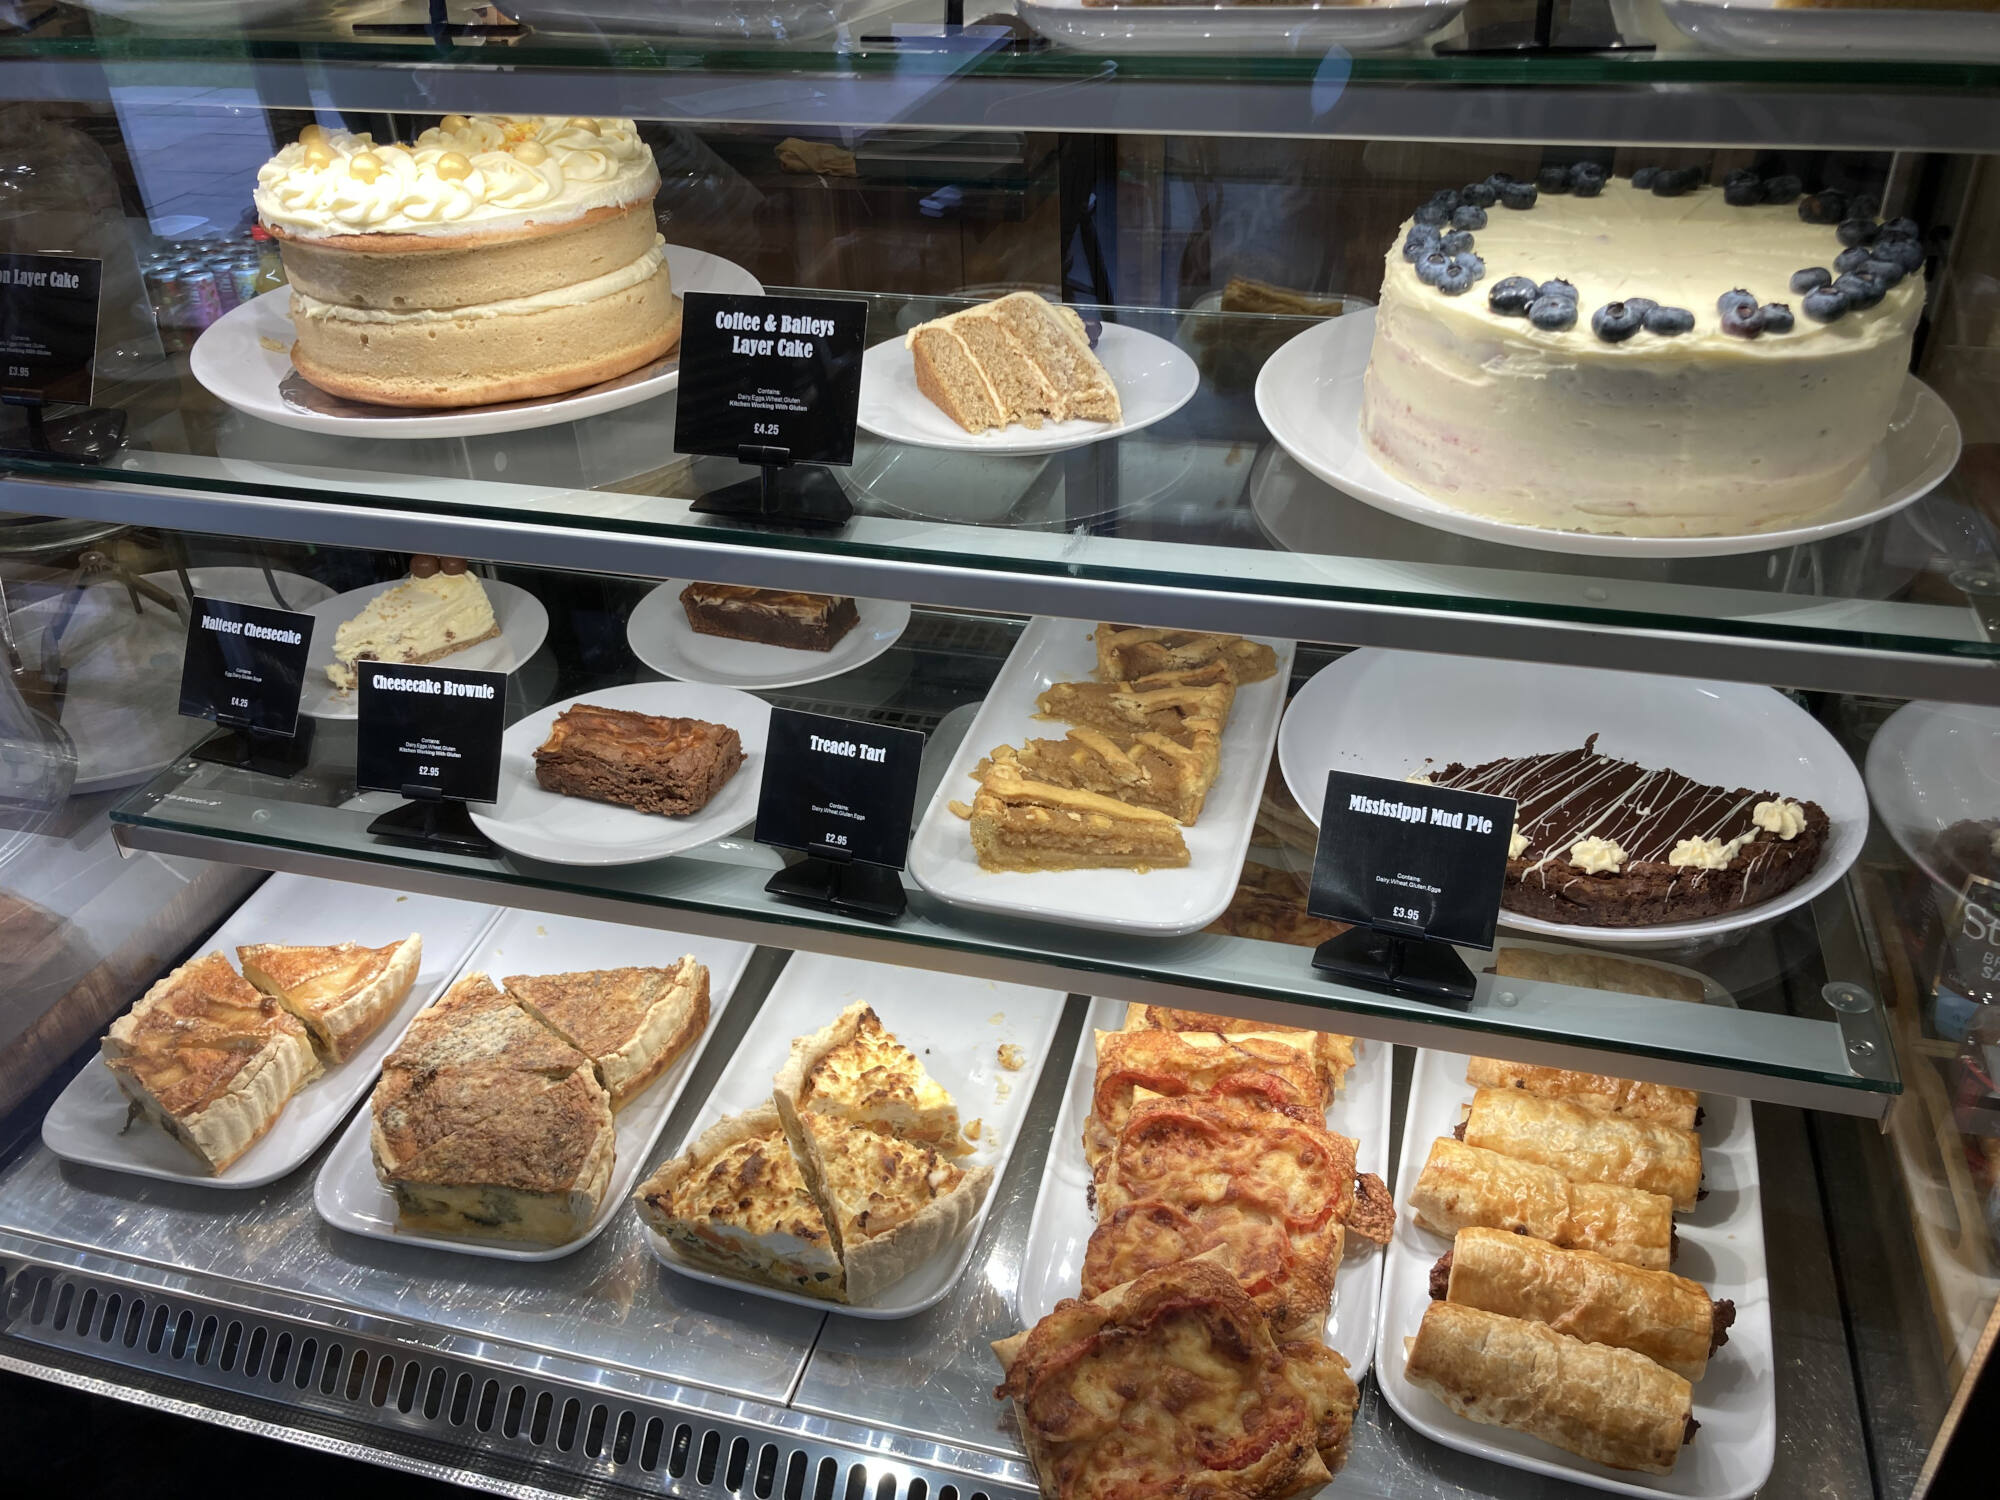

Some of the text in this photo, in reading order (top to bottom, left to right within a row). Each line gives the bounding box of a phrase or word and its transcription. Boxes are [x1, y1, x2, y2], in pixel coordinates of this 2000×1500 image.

[13, 268, 47, 287] Layer
[50, 271, 80, 289] Cake
[715, 311, 835, 338] Coffee & Baileys
[732, 336, 814, 358] Layer Cake
[8, 366, 30, 377] £3.95
[728, 400, 751, 408] Kitchen
[751, 402, 775, 410] Working
[788, 404, 808, 412] Gluten
[753, 422, 780, 435] £4.25
[201, 614, 302, 645] Malteser Cheesecake
[372, 674, 495, 700] Cheesecake Brownie
[231, 696, 248, 708] £4.25
[809, 734, 887, 763] Treacle Tart
[418, 765, 440, 777] £2.95
[1348, 793, 1494, 834] Mississippi Mud Pie
[825, 832, 848, 846] £2.95
[1392, 906, 1420, 921] £3.95
